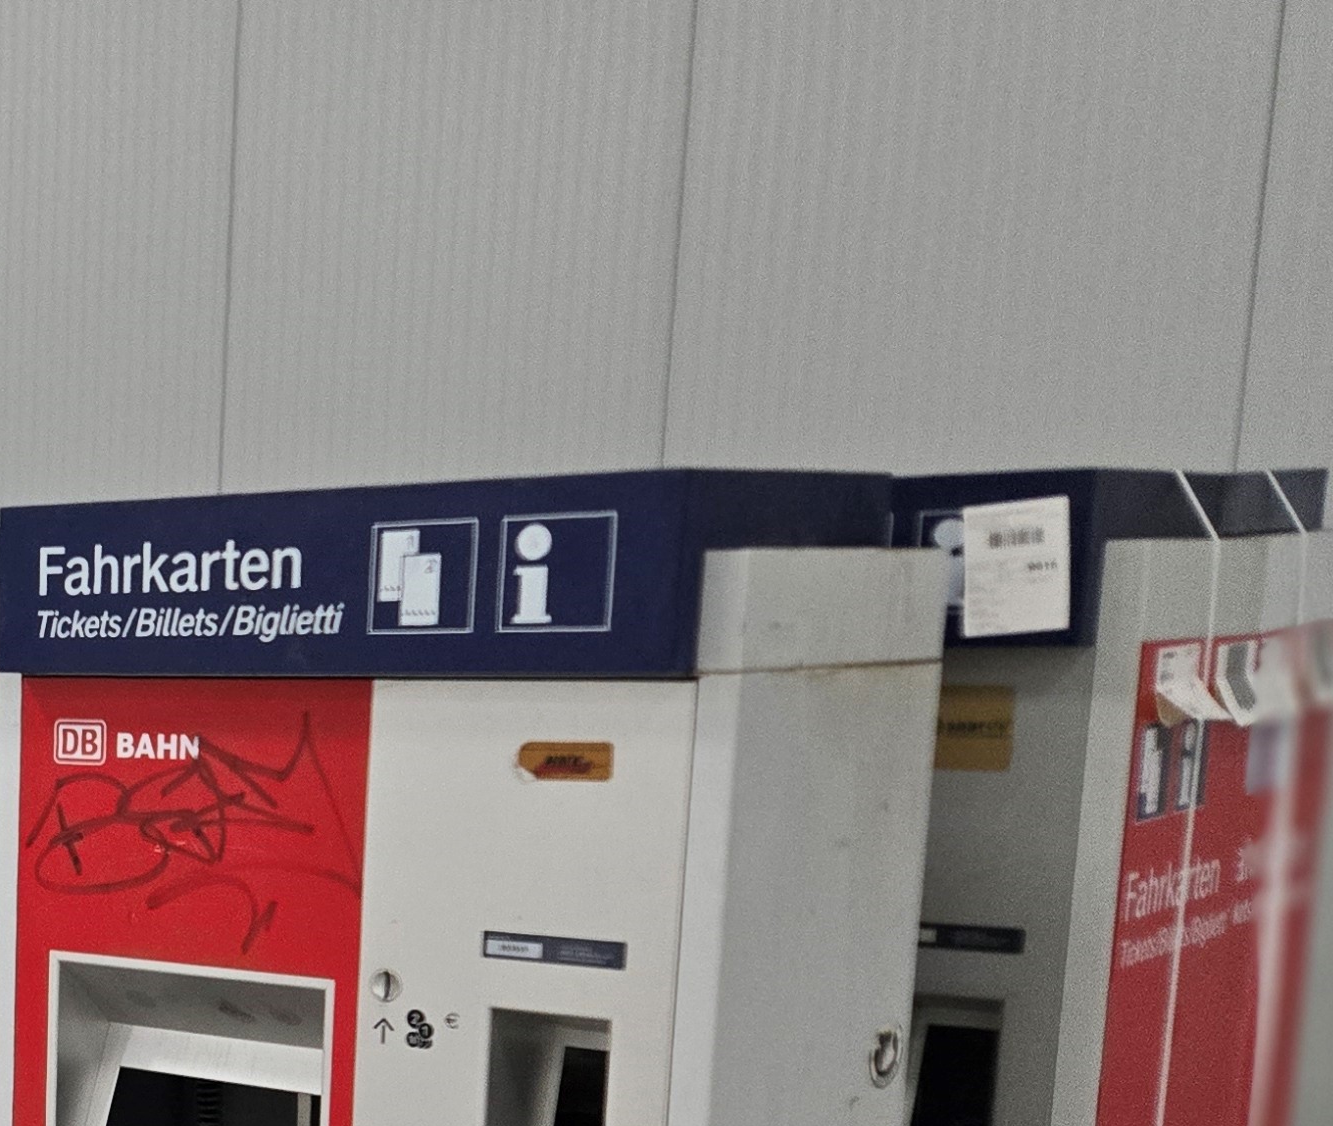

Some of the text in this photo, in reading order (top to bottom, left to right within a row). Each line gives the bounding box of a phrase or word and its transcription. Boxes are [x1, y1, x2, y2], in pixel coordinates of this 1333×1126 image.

[38, 539, 302, 597] Fahrkarten
[36, 602, 345, 643] Tickets/Billets/Biglietti
[57, 723, 200, 761] DB BAHN
